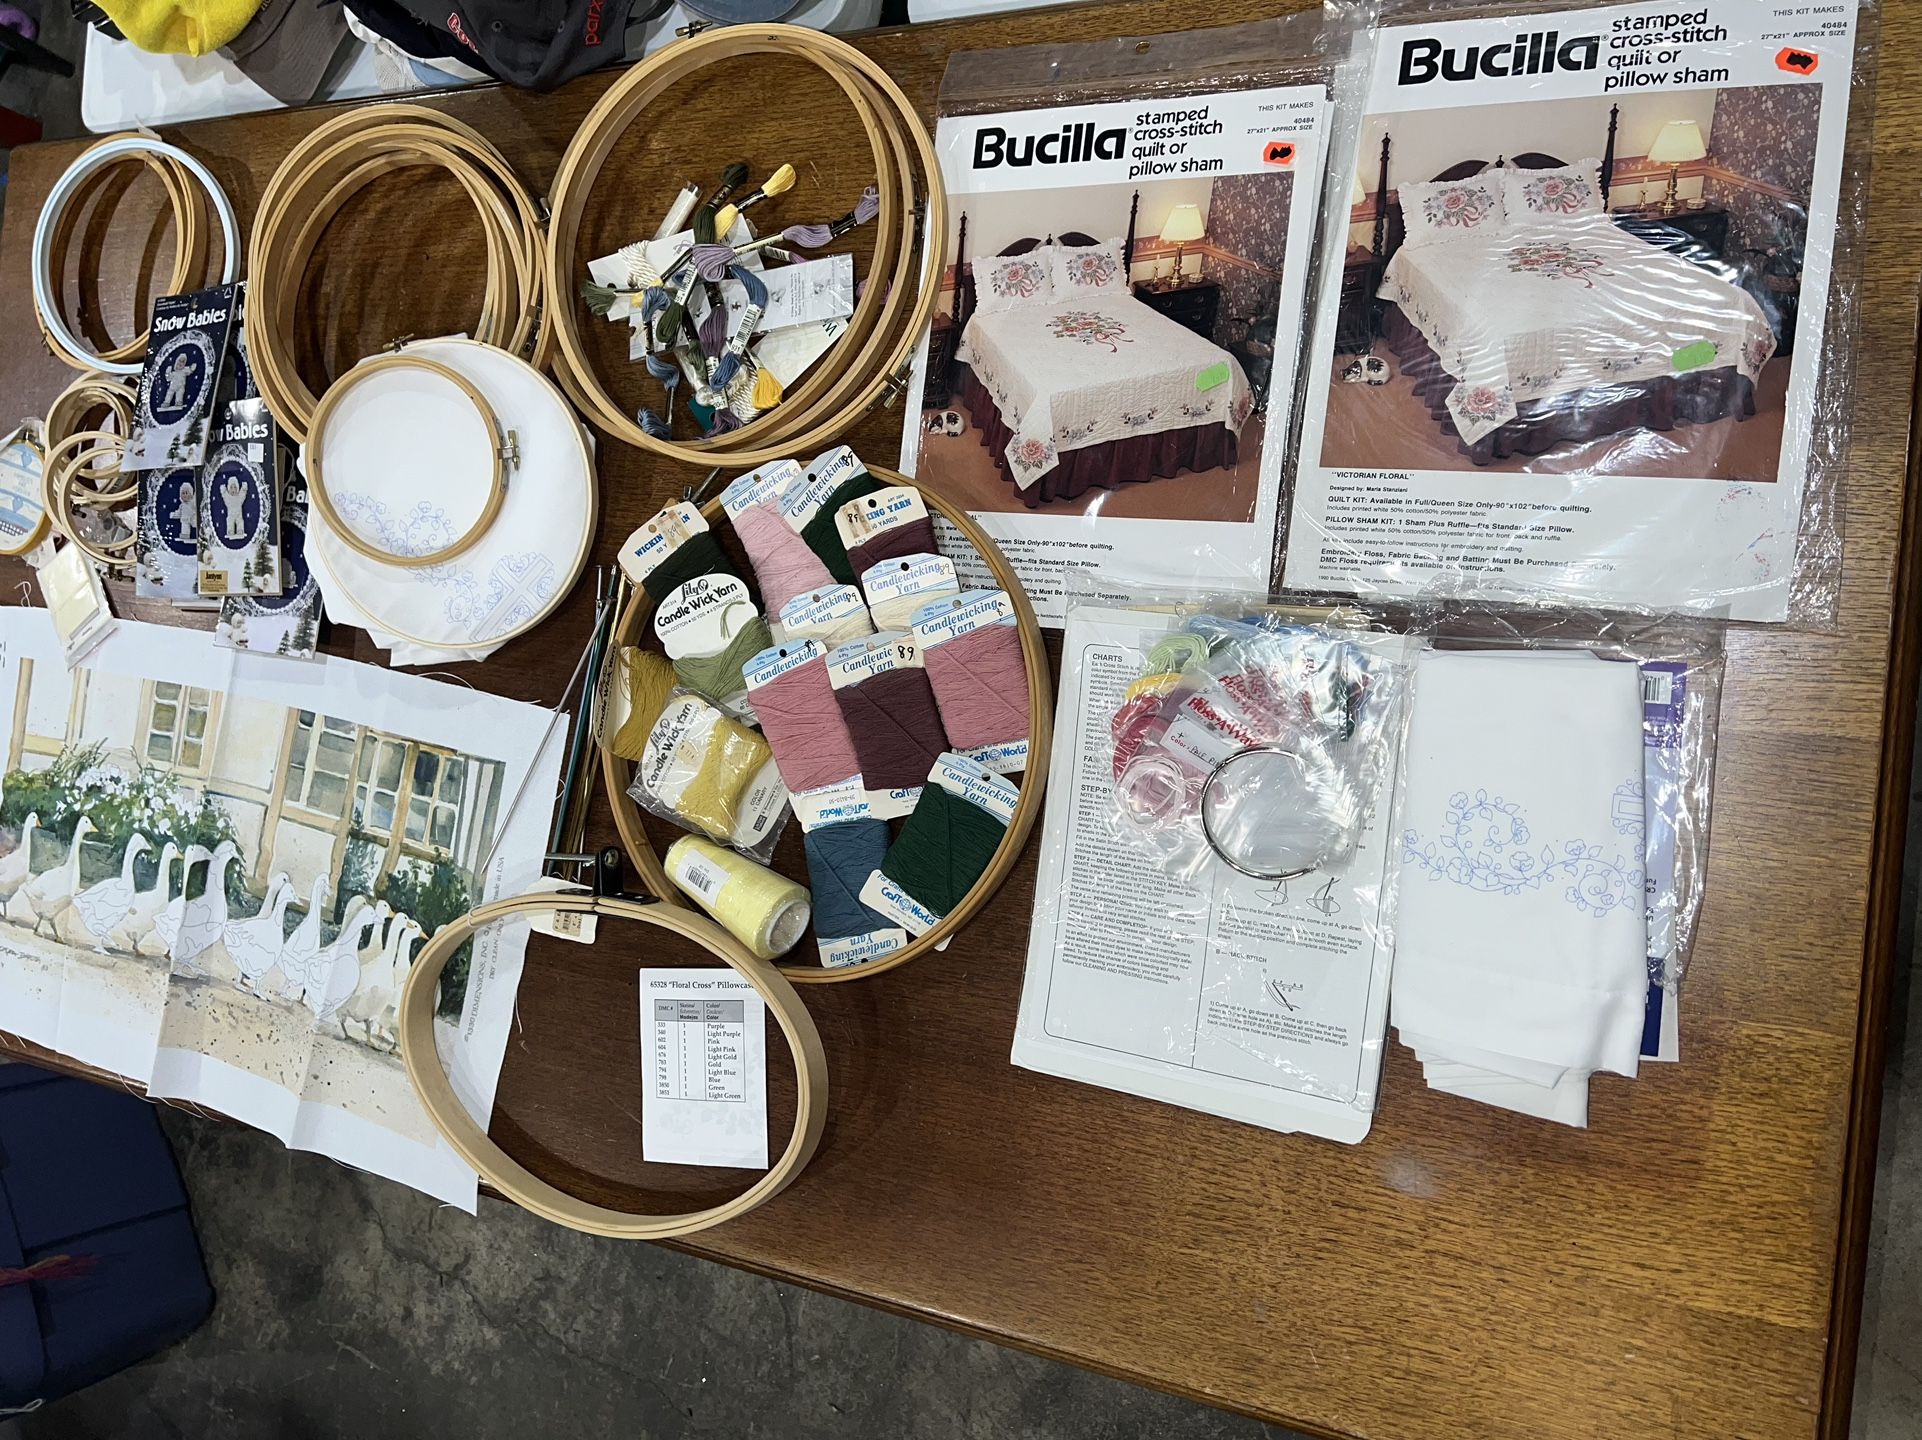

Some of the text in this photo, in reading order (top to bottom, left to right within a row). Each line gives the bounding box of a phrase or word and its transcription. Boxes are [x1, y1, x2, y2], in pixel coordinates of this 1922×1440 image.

[1773, 5, 1845, 17] THIS KIT MAKES
[1612, 8, 1708, 32] stamped
[1821, 21, 1847, 29] 40484
[1610, 25, 1728, 49] cross-stitch
[1793, 30, 1825, 38] APPROX
[1829, 29, 1846, 37] SIZE
[1398, 30, 1600, 86] Bucilla
[1607, 49, 1682, 70] quilt or
[1604, 67, 1729, 92] pillow sham
[1258, 101, 1314, 112] THIS KIT MAKES
[1136, 105, 1209, 126] stamped
[1293, 117, 1315, 125] 40484
[1134, 120, 1223, 141] cross-stitch
[1271, 125, 1297, 133] APPROX
[973, 122, 1127, 169] Bucilla
[1132, 142, 1188, 160] quilt or
[1129, 157, 1224, 180] pillow sham
[153, 308, 227, 333] Snow Babies
[225, 422, 269, 441] Babies
[731, 467, 792, 513] Candlewicking
[790, 455, 846, 518] Candlewicking
[813, 485, 835, 507] Yarn
[887, 498, 912, 514] YARN
[1370, 497, 1403, 505] Available
[1414, 499, 1455, 507] Full/Queen
[1457, 501, 1474, 509] Size
[1560, 504, 1592, 513] quilting.
[879, 516, 898, 527] YARDS
[1405, 519, 1426, 527] Sham
[1548, 525, 1575, 534] Pillow.
[1405, 541, 1439, 549] instructions
[1039, 558, 1065, 566] Standard
[1320, 556, 1443, 570] DMC Floss available
[1364, 551, 1386, 559] Floss,
[1388, 551, 1412, 559] Fabric
[1446, 554, 1460, 562] and
[1492, 557, 1511, 565] Must
[1513, 557, 1525, 566] Be
[870, 562, 940, 592] Candlewicking
[895, 580, 921, 595] Yarn
[1097, 592, 1132, 601] Separately.
[657, 605, 690, 628] Candle
[688, 592, 719, 610] Wick
[713, 582, 738, 598] Yarn
[788, 592, 848, 627] Candlewicking
[921, 600, 998, 635] Candlewicking
[670, 621, 689, 632] COTTON
[949, 620, 976, 636] Yarn
[897, 645, 914, 661] 89
[1092, 653, 1123, 663] CHARTS
[754, 648, 819, 684] Candlewicking
[869, 659, 895, 675] Yarn
[646, 703, 693, 788] Candle Wick Yarn
[942, 766, 1017, 808] Candlewicking
[962, 786, 988, 806] Yarn
[850, 934, 874, 946] Yarn
[830, 937, 898, 962] Candlewicking
[650, 981, 668, 989] 65328
[692, 981, 716, 989] Cross"
[707, 1023, 725, 1031] Purple
[722, 1031, 741, 1039] Purple
[708, 1053, 722, 1061] Light
[708, 1069, 722, 1077] Light
